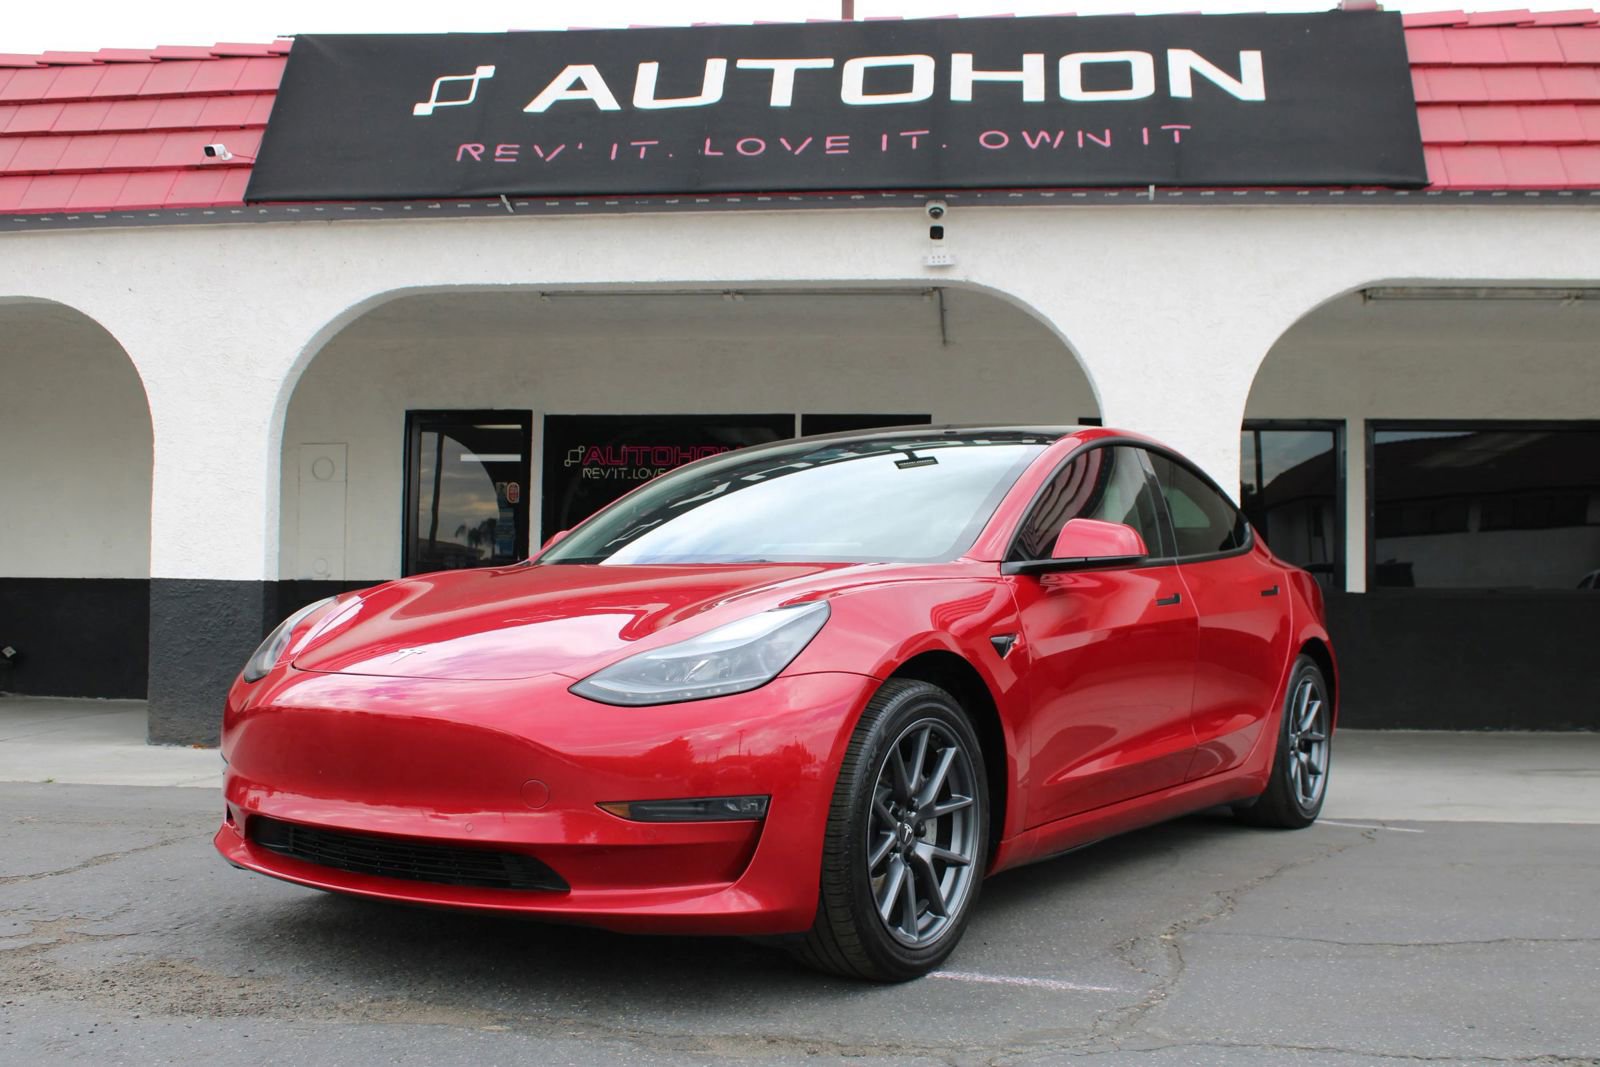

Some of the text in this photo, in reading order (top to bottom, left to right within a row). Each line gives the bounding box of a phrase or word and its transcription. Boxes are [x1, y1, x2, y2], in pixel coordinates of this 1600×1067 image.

[523, 48, 1266, 112] AUTOHON
[610, 140, 673, 161] IT.
[704, 136, 850, 156] LOVE
[881, 130, 948, 151] IT.
[979, 128, 1111, 149] OWN
[1142, 125, 1192, 146] IT
